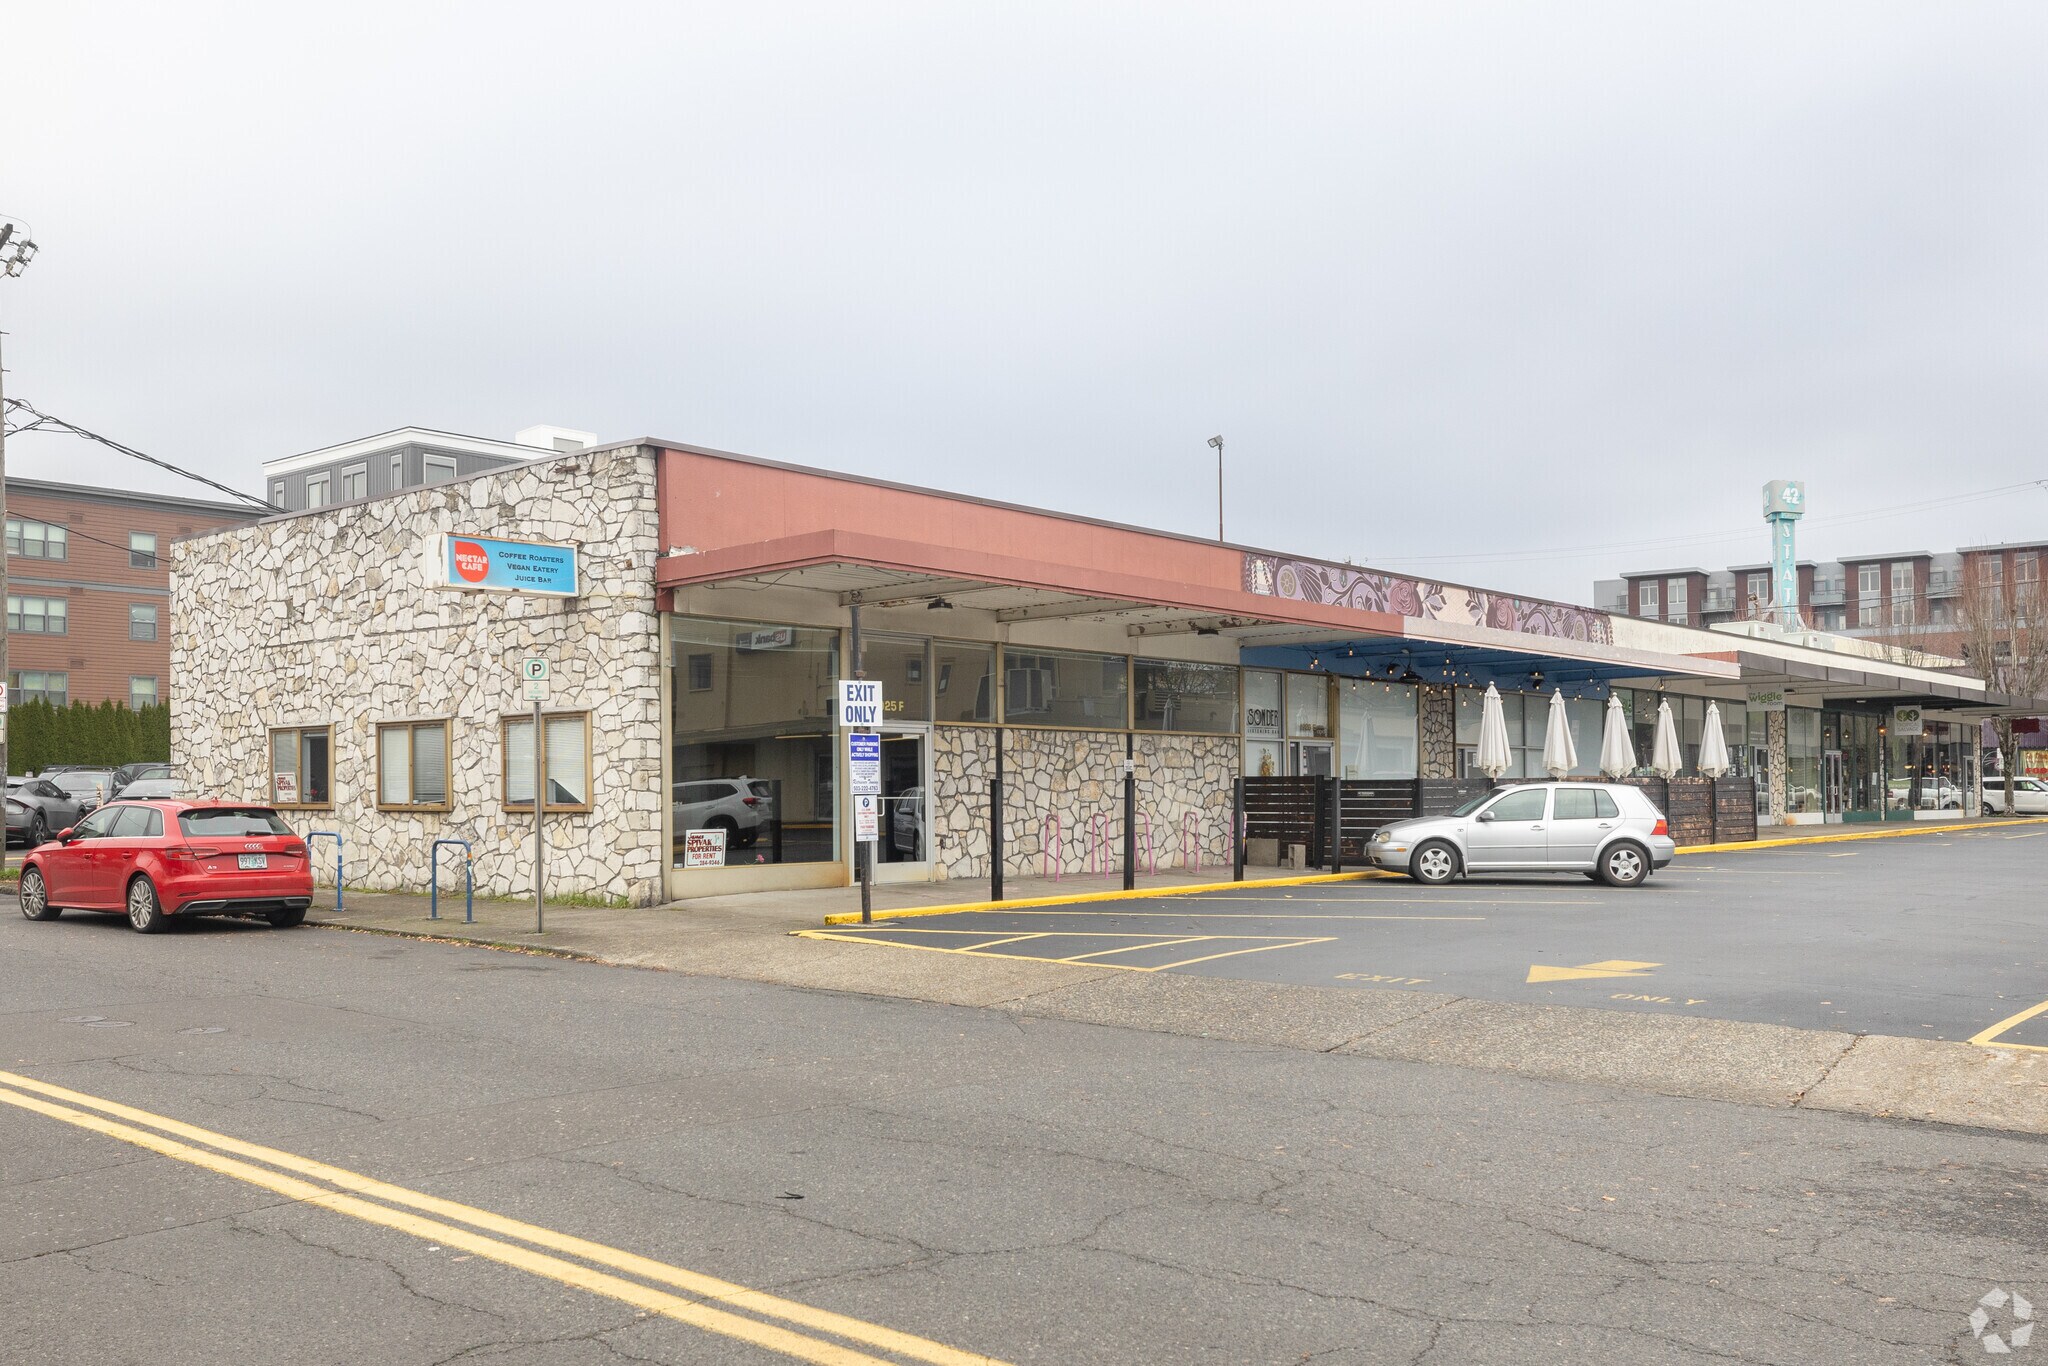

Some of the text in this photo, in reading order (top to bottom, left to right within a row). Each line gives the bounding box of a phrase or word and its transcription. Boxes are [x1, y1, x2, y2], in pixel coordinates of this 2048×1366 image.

[1782, 487, 1800, 504] 42
[455, 553, 488, 564] NECTAR
[498, 551, 564, 563] COFFEE ROASTERS
[461, 562, 483, 571] CAFE
[507, 563, 559, 573] VEGAN EATERY
[532, 664, 542, 676] P
[846, 684, 875, 701] EXIT
[1749, 691, 1783, 703] wiggle
[898, 701, 904, 711] F
[845, 705, 877, 723] ONLY
[1247, 708, 1279, 727] SONDER
[240, 857, 250, 866] 997
[1334, 972, 1433, 985] EXIT
[1610, 993, 1708, 1006] ONLY
